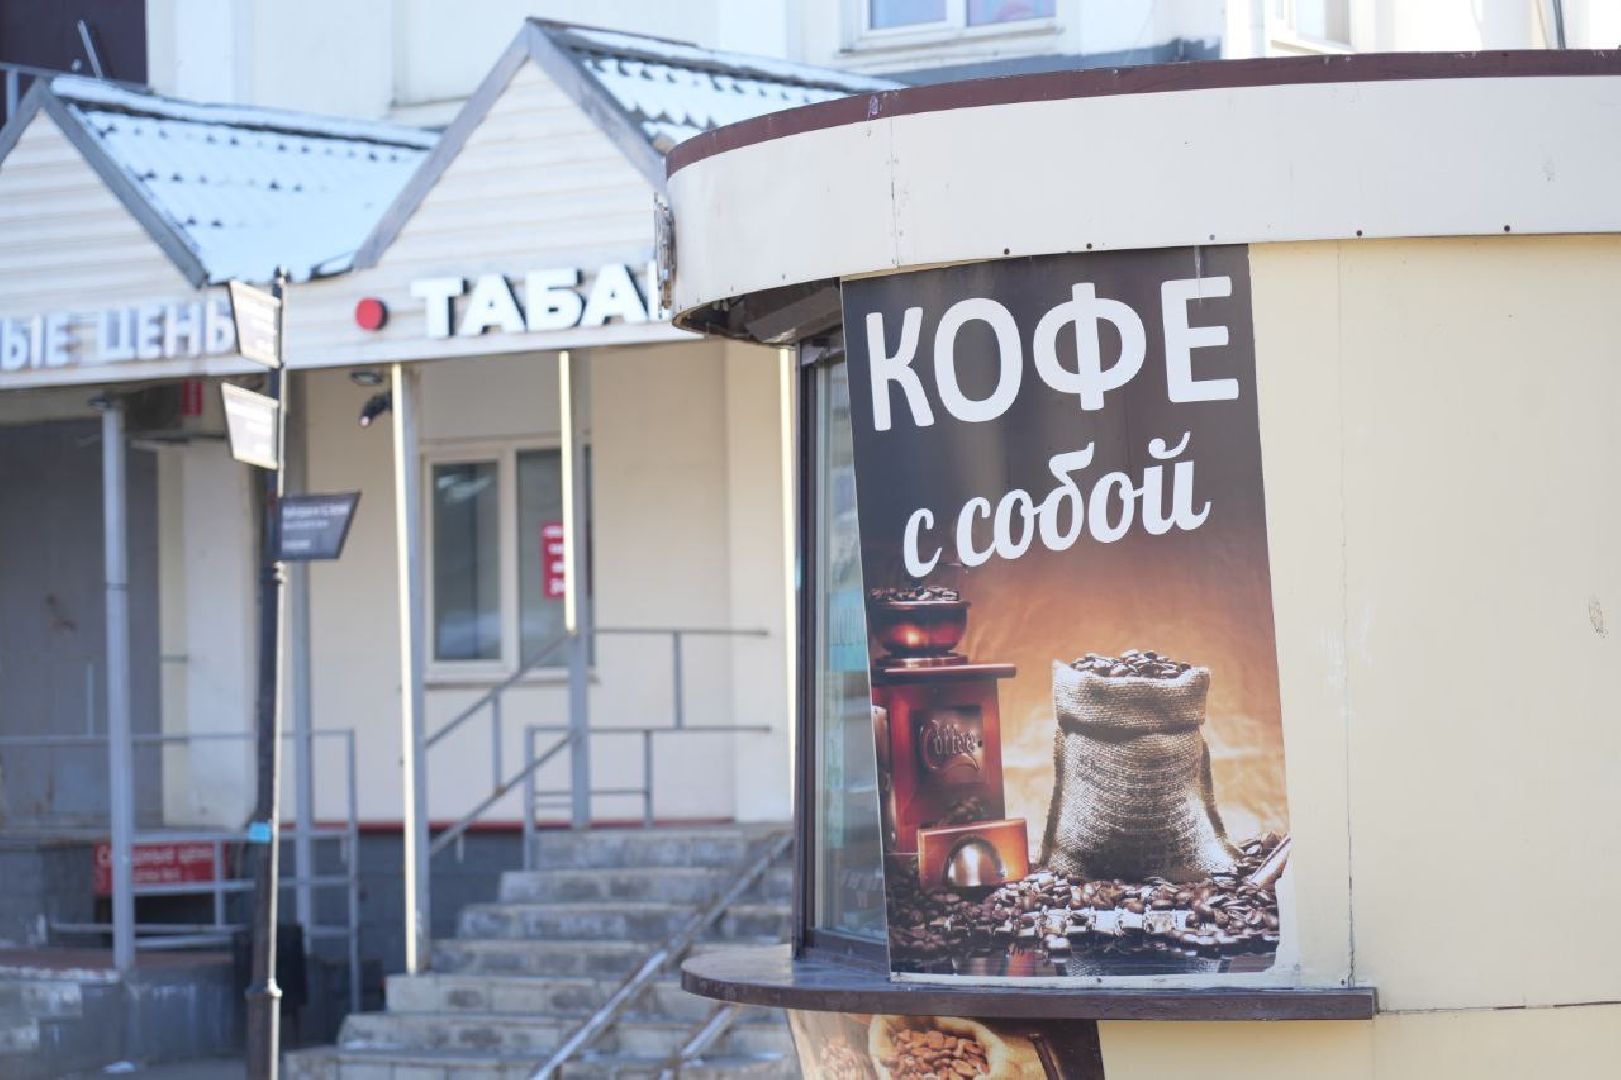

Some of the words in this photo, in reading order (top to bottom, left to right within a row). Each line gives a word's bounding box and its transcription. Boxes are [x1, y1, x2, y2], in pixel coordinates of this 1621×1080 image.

[866, 275, 1239, 431] КОФЕ
[904, 508, 942, 577] с
[956, 431, 1211, 567] собой
